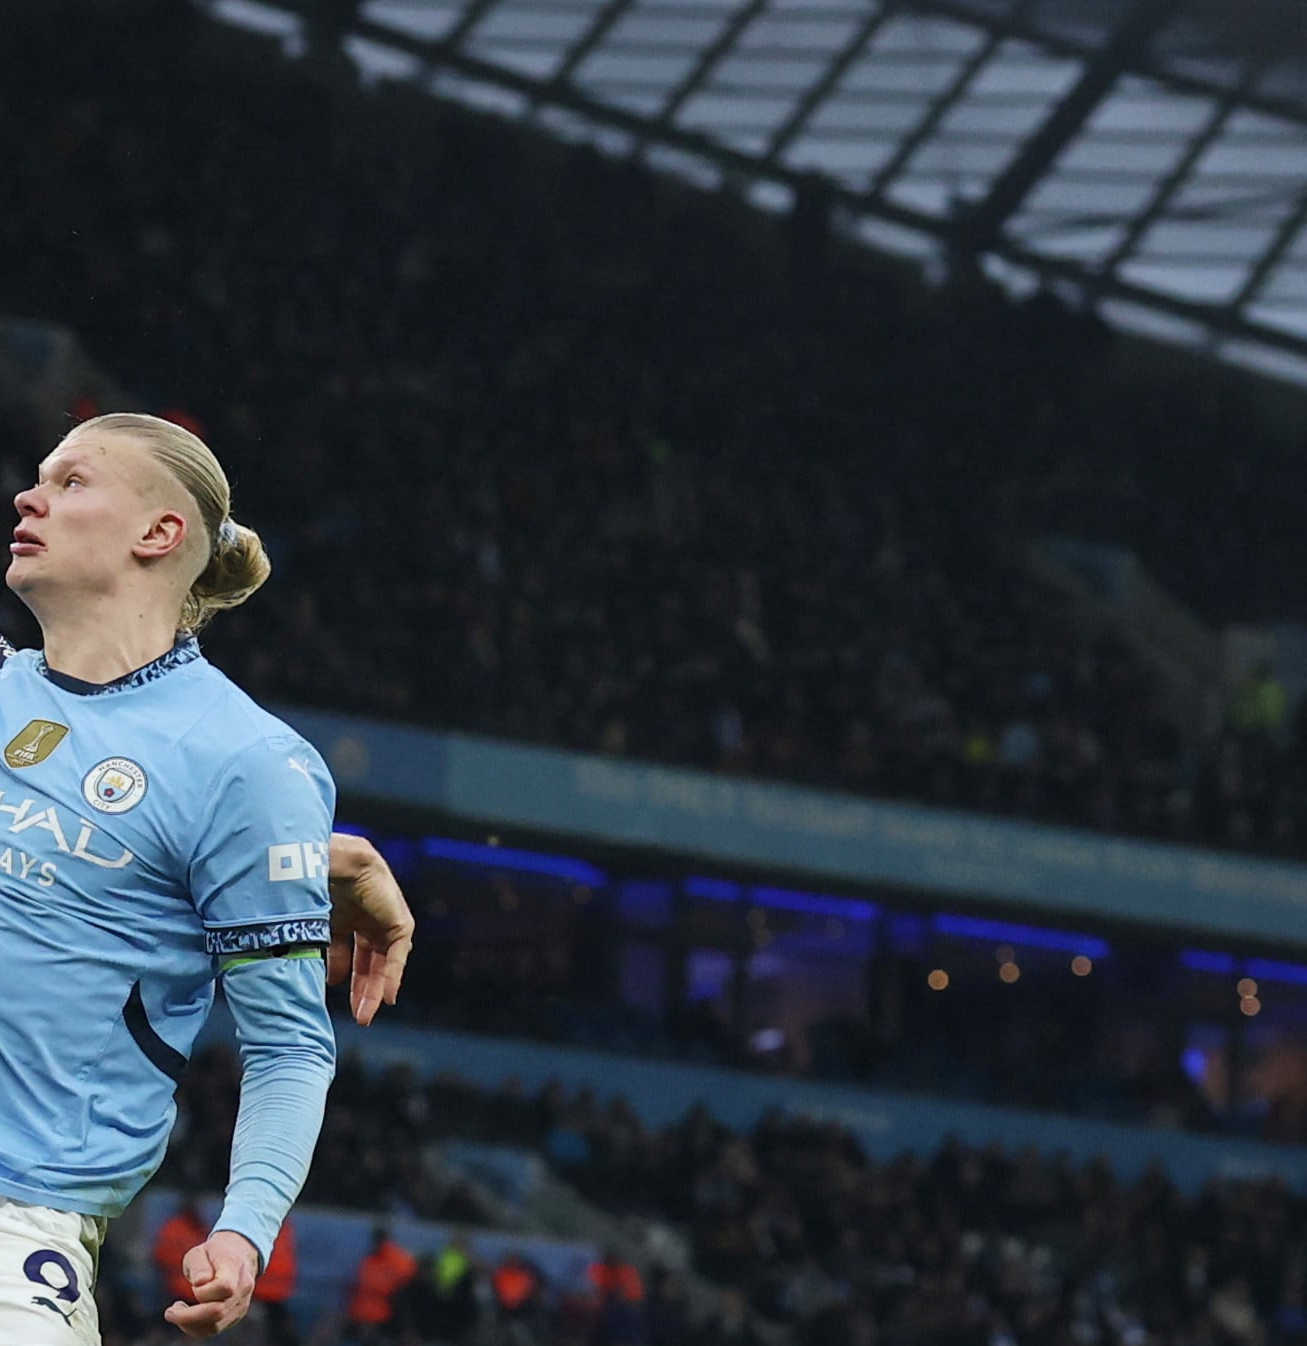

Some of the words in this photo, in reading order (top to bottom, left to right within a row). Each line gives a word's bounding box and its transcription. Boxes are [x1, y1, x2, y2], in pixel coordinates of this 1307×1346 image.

[13, 749, 35, 761] FIFA
[98, 760, 144, 789] MANCHESTER
[92, 799, 111, 811] CITY
[23, 1249, 81, 1303] 9
